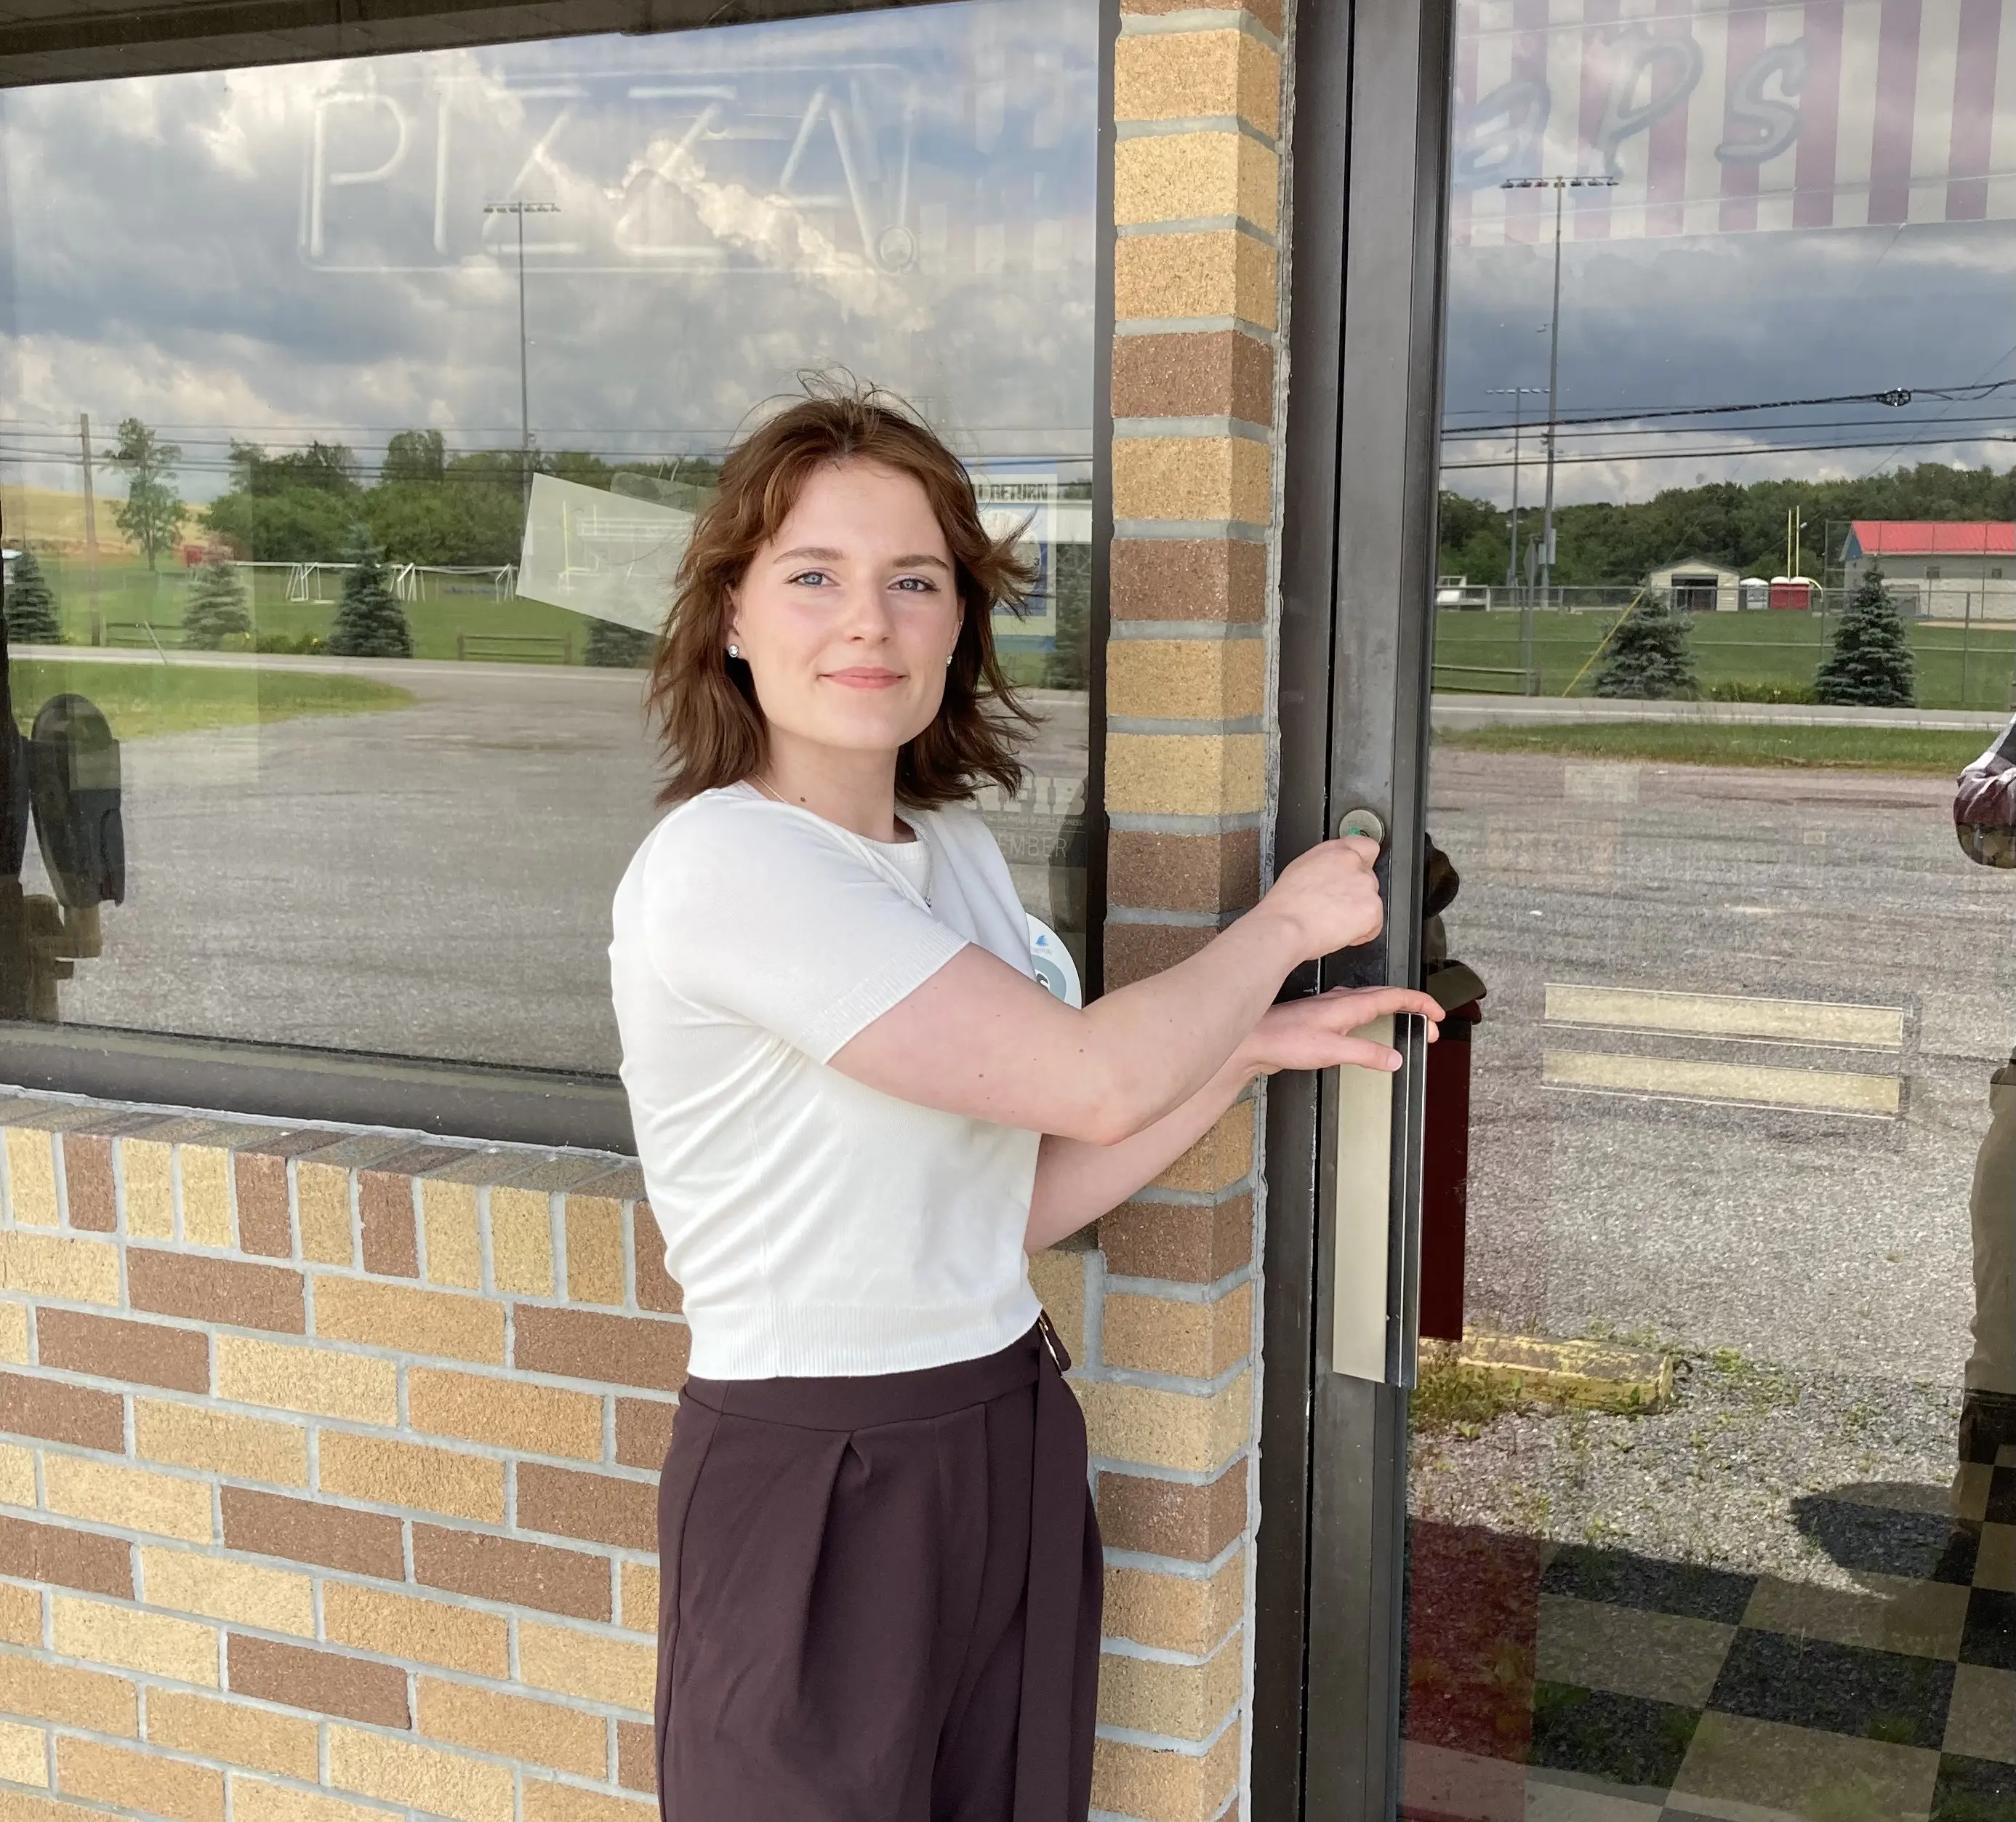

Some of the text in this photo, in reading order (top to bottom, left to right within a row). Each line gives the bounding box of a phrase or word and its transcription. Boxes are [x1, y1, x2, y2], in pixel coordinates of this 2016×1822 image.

[310, 81, 876, 258] PIZZA
[989, 483, 1048, 500] RETURN
[997, 834, 1067, 858] EMBER
